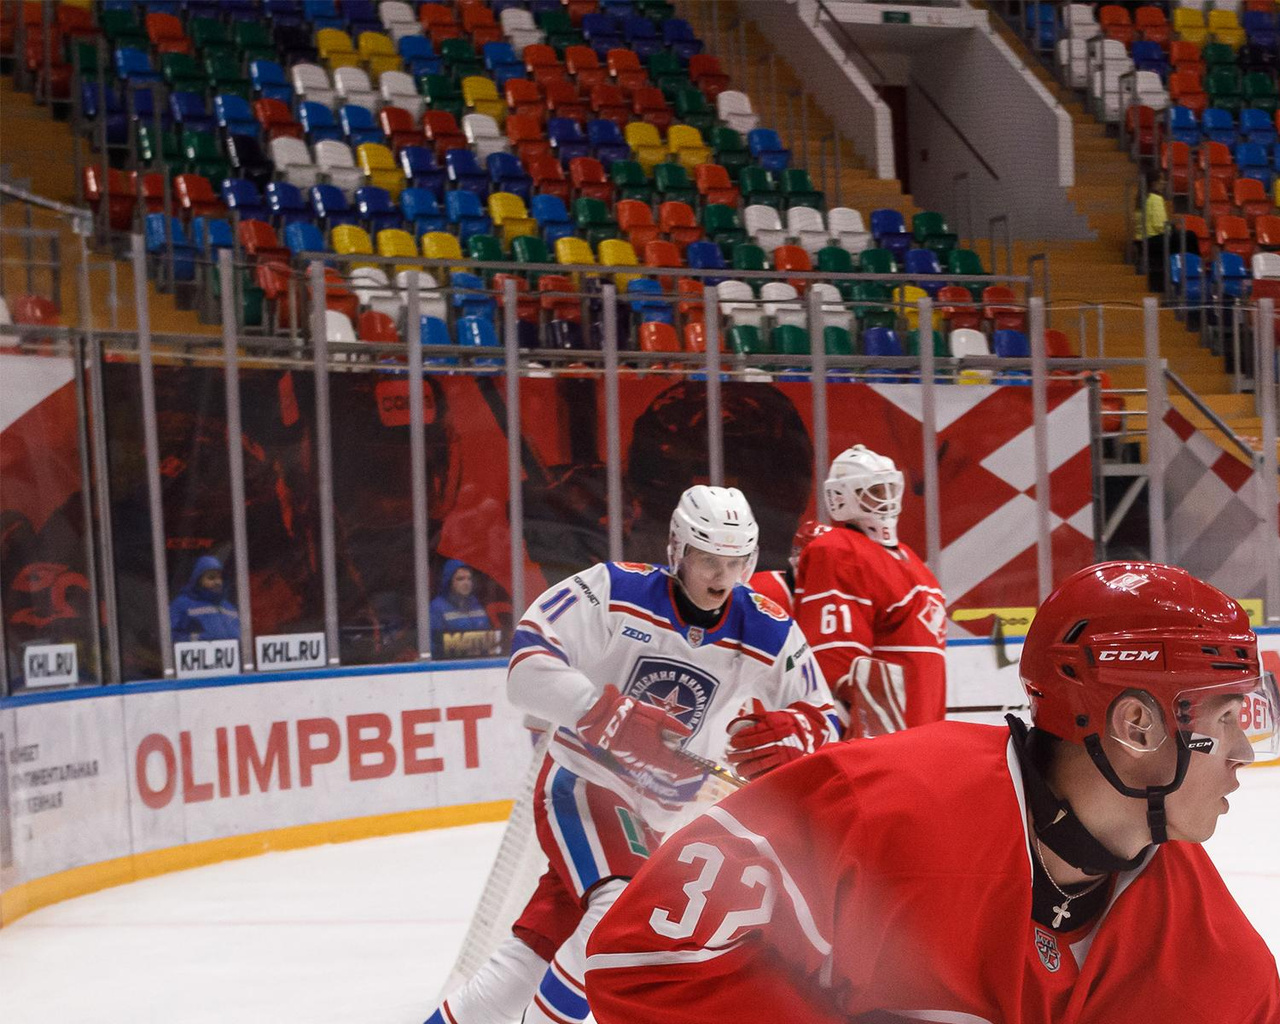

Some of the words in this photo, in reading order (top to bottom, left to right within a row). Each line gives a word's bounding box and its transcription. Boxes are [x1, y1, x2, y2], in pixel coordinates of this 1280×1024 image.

[540, 587, 580, 624] 11
[820, 603, 852, 635] 61
[622, 626, 652, 644] ZEDO
[180, 647, 234, 671] KHL.RU
[262, 640, 320, 663] KHL.RU
[1099, 650, 1160, 661] CCM
[29, 653, 73, 678] KHL.RU
[136, 704, 493, 809] OLIMPBET
[1188, 741, 1213, 749] CCM
[649, 842, 772, 948] 32
